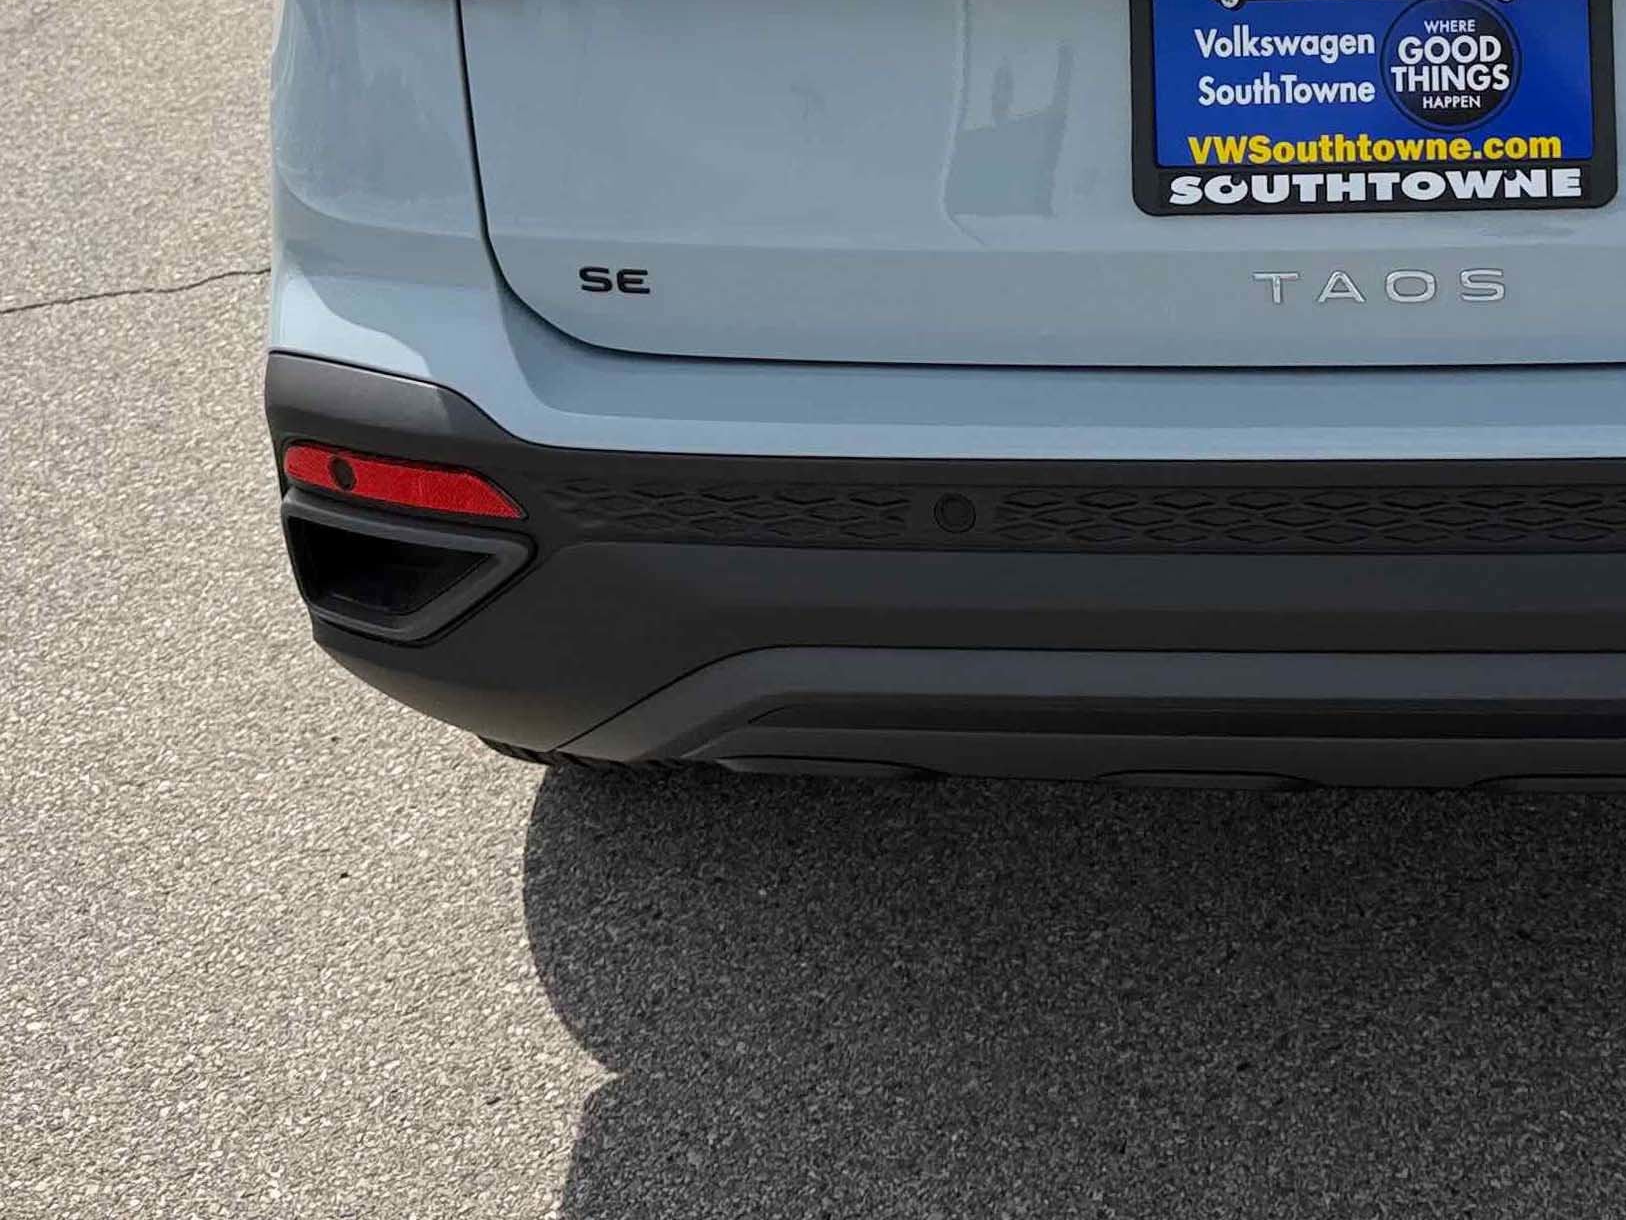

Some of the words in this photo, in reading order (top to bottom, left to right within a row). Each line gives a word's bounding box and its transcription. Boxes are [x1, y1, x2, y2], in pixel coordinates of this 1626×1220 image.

[1424, 19, 1476, 34] WHERE
[1194, 24, 1375, 64] Volkswagen
[1397, 35, 1502, 65] GOOD
[1198, 72, 1376, 106] SouthTowne
[1390, 63, 1511, 92] THINGS
[1422, 95, 1482, 109] HAPPEN
[1187, 133, 1562, 165] VWSouthtowne.com
[1169, 168, 1583, 205] SOUTHTOWNE
[579, 266, 651, 295] SE
[1252, 269, 1505, 304] TAOS
